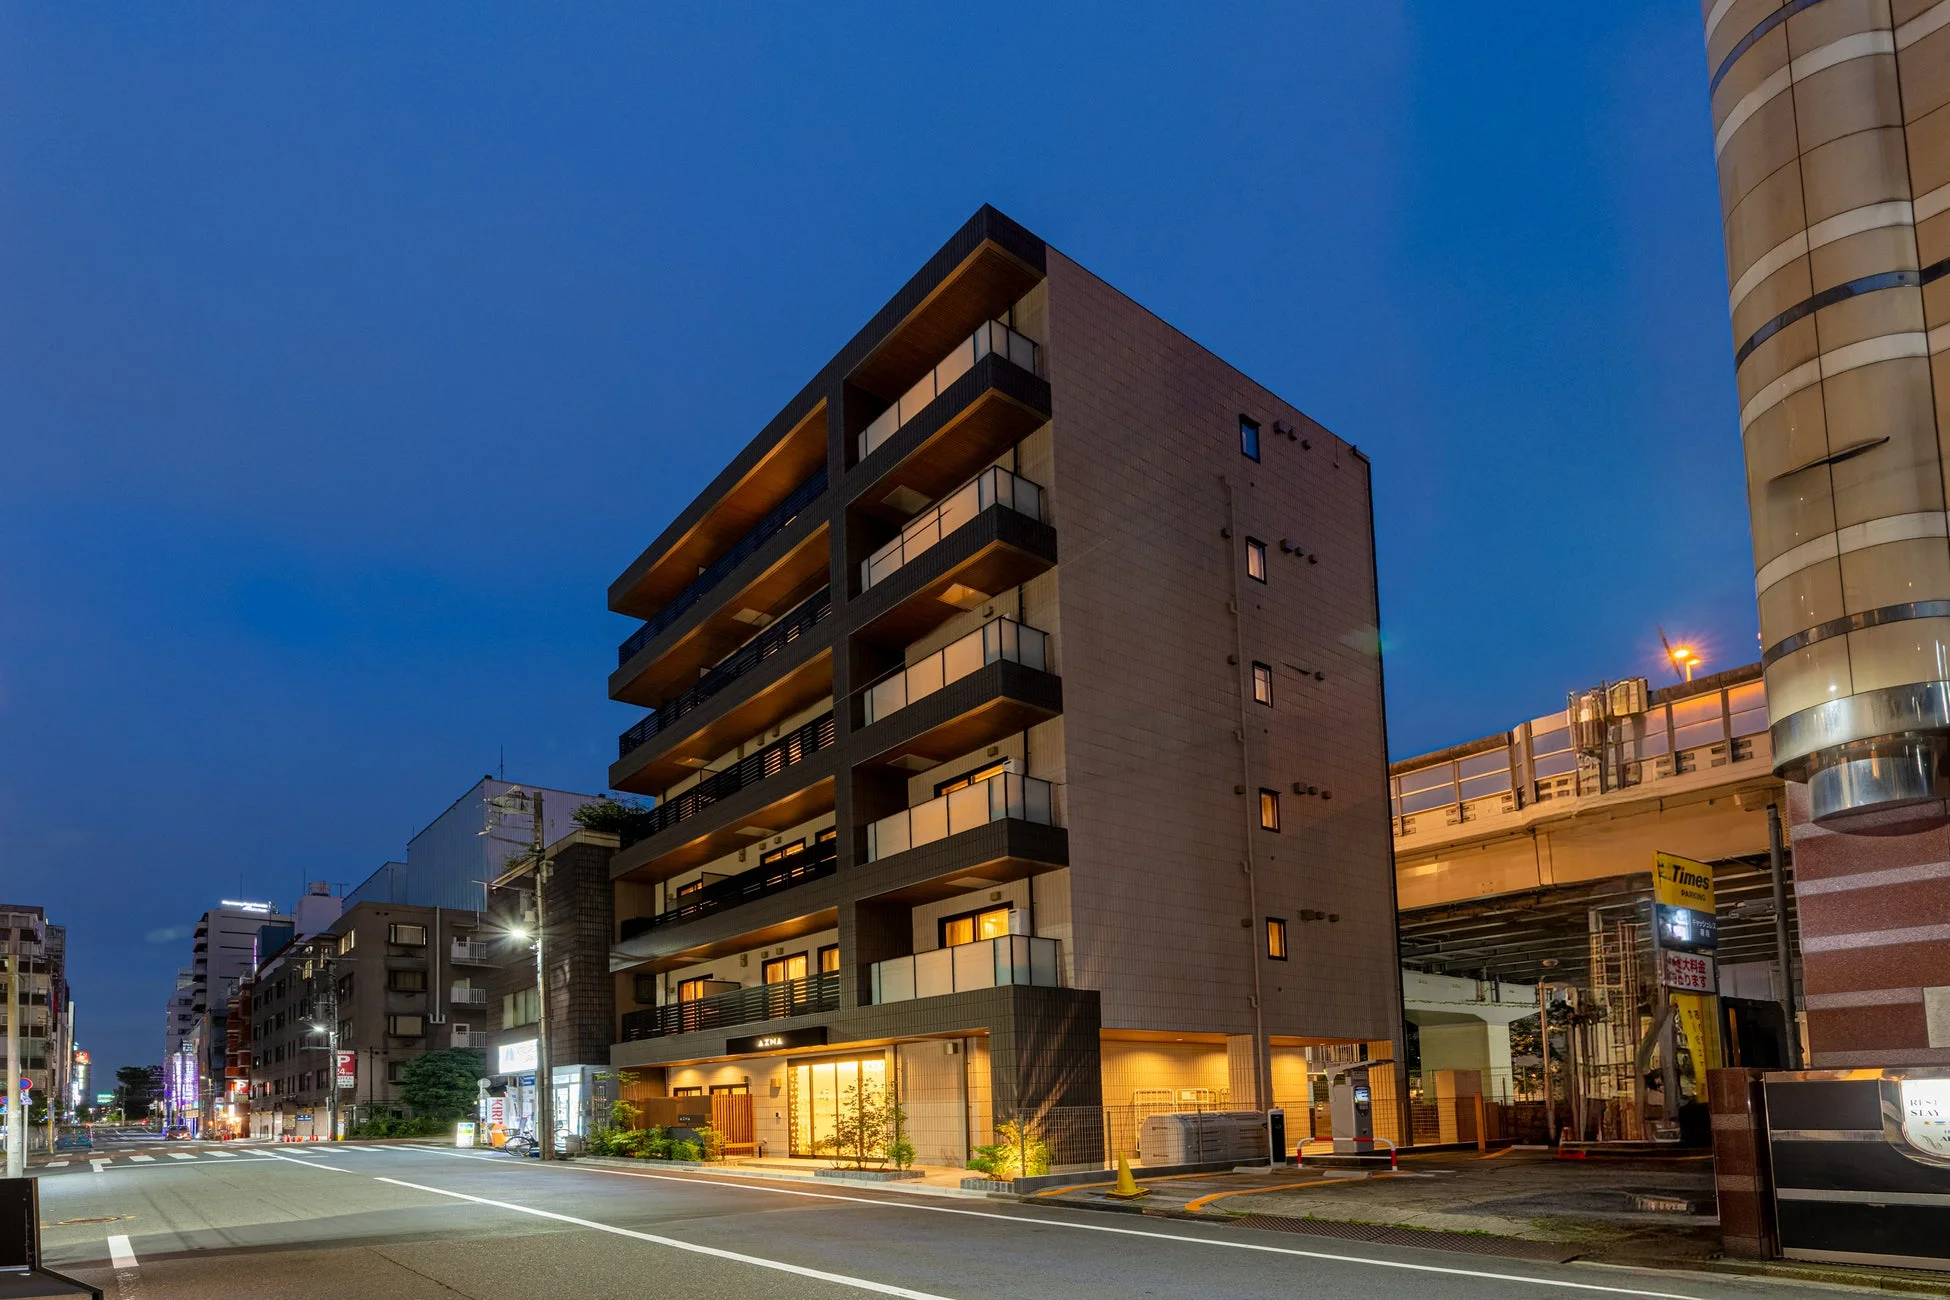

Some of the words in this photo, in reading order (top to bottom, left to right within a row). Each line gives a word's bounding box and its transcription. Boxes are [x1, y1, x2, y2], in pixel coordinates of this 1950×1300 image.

[1672, 864, 1709, 889] Times
[1681, 889, 1706, 901] PARKING
[491, 1098, 503, 1125] KIRI
